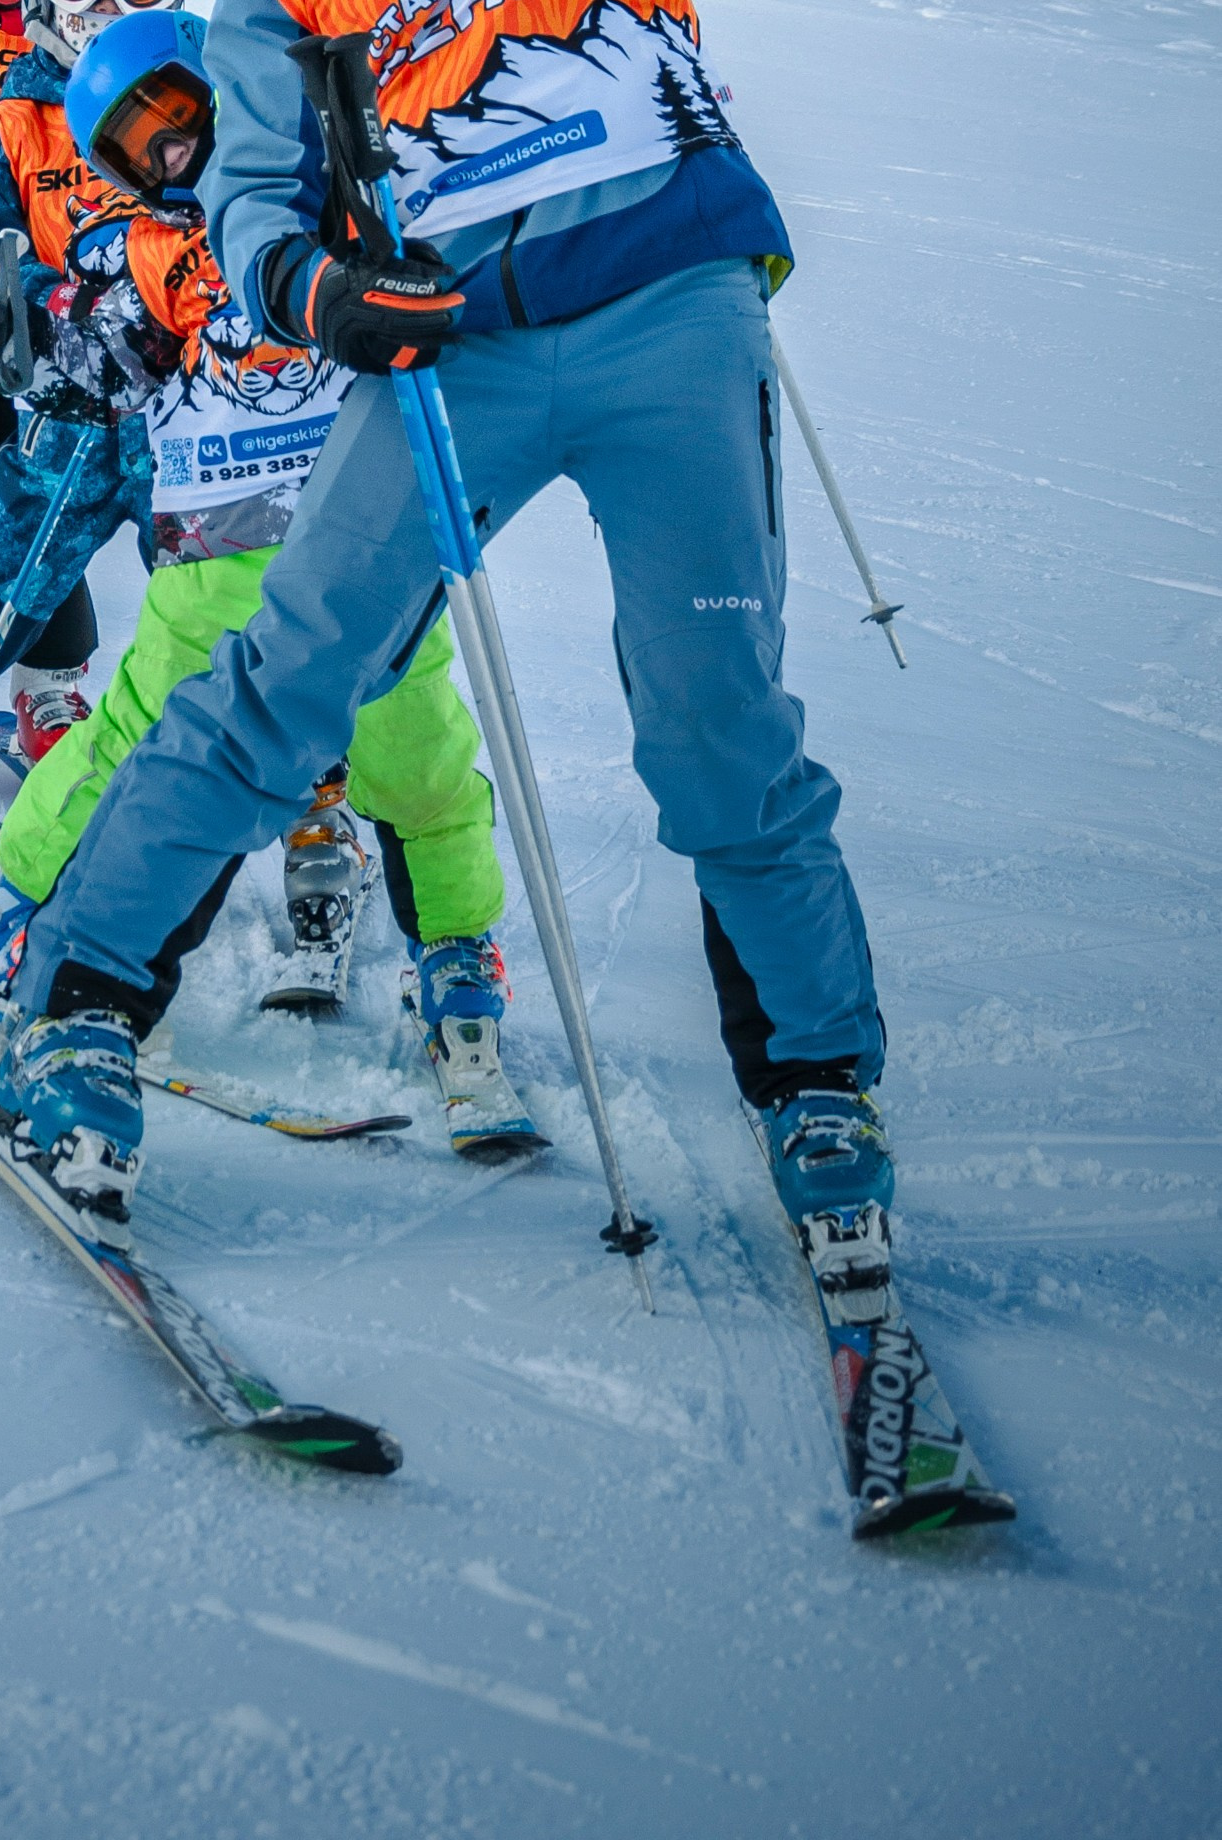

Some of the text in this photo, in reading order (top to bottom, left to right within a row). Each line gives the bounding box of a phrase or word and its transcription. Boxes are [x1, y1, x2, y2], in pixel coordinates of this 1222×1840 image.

[362, 107, 383, 152] LEKI
[36, 164, 83, 193] SKI
[163, 246, 201, 292] SKI
[375, 277, 437, 295] reusch
[199, 470, 214, 483] 8
[219, 462, 261, 481] 928
[692, 595, 763, 612] buono
